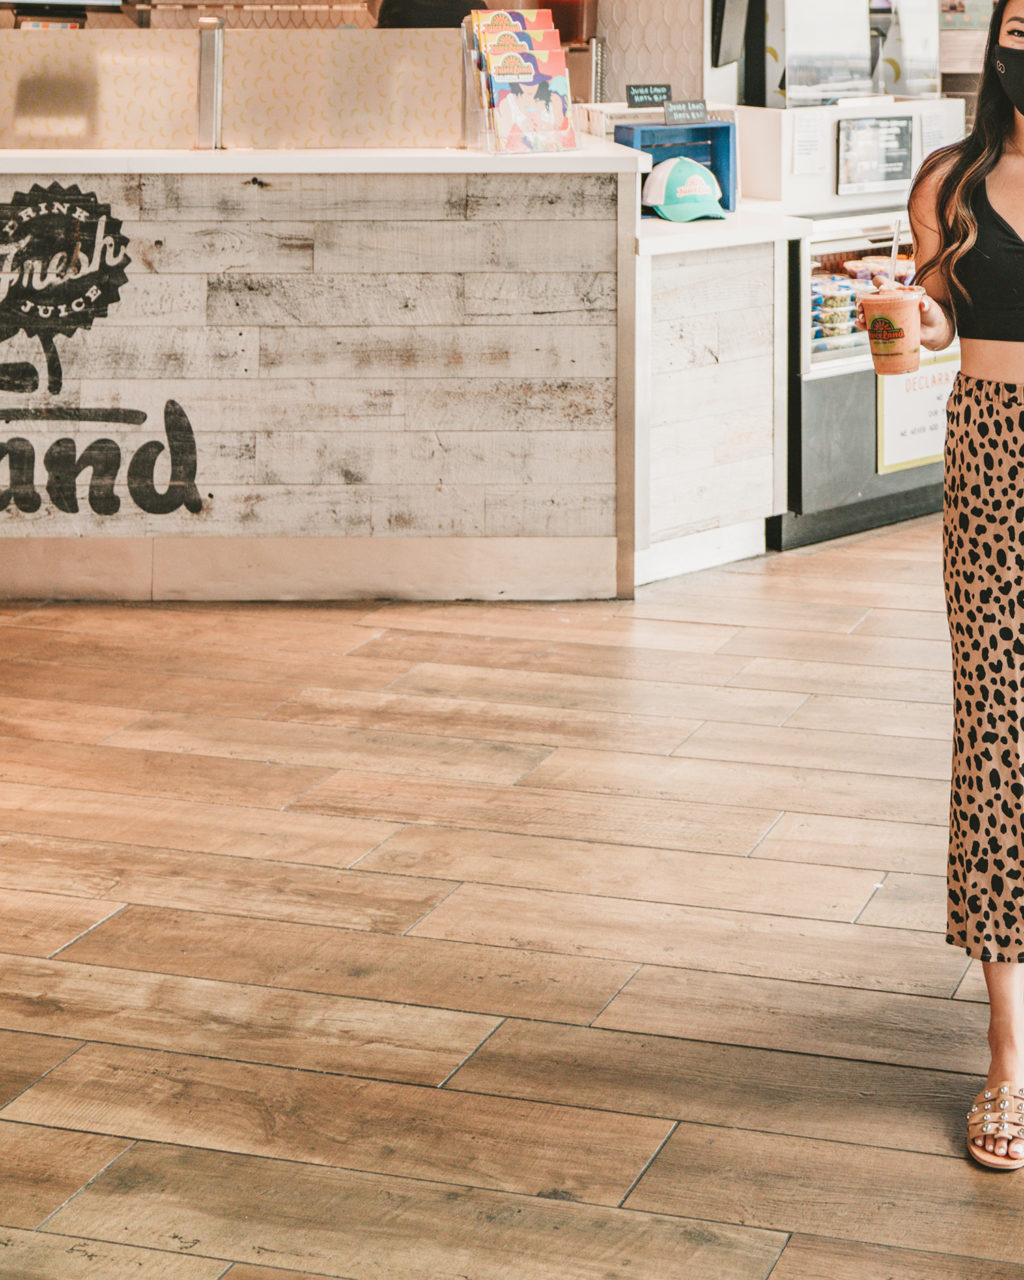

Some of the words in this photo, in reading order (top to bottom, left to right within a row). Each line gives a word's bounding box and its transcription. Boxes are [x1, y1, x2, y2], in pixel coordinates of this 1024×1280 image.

[2, 201, 90, 237] DRINK
[0, 215, 126, 302] Fresh
[20, 285, 101, 318] JUICE
